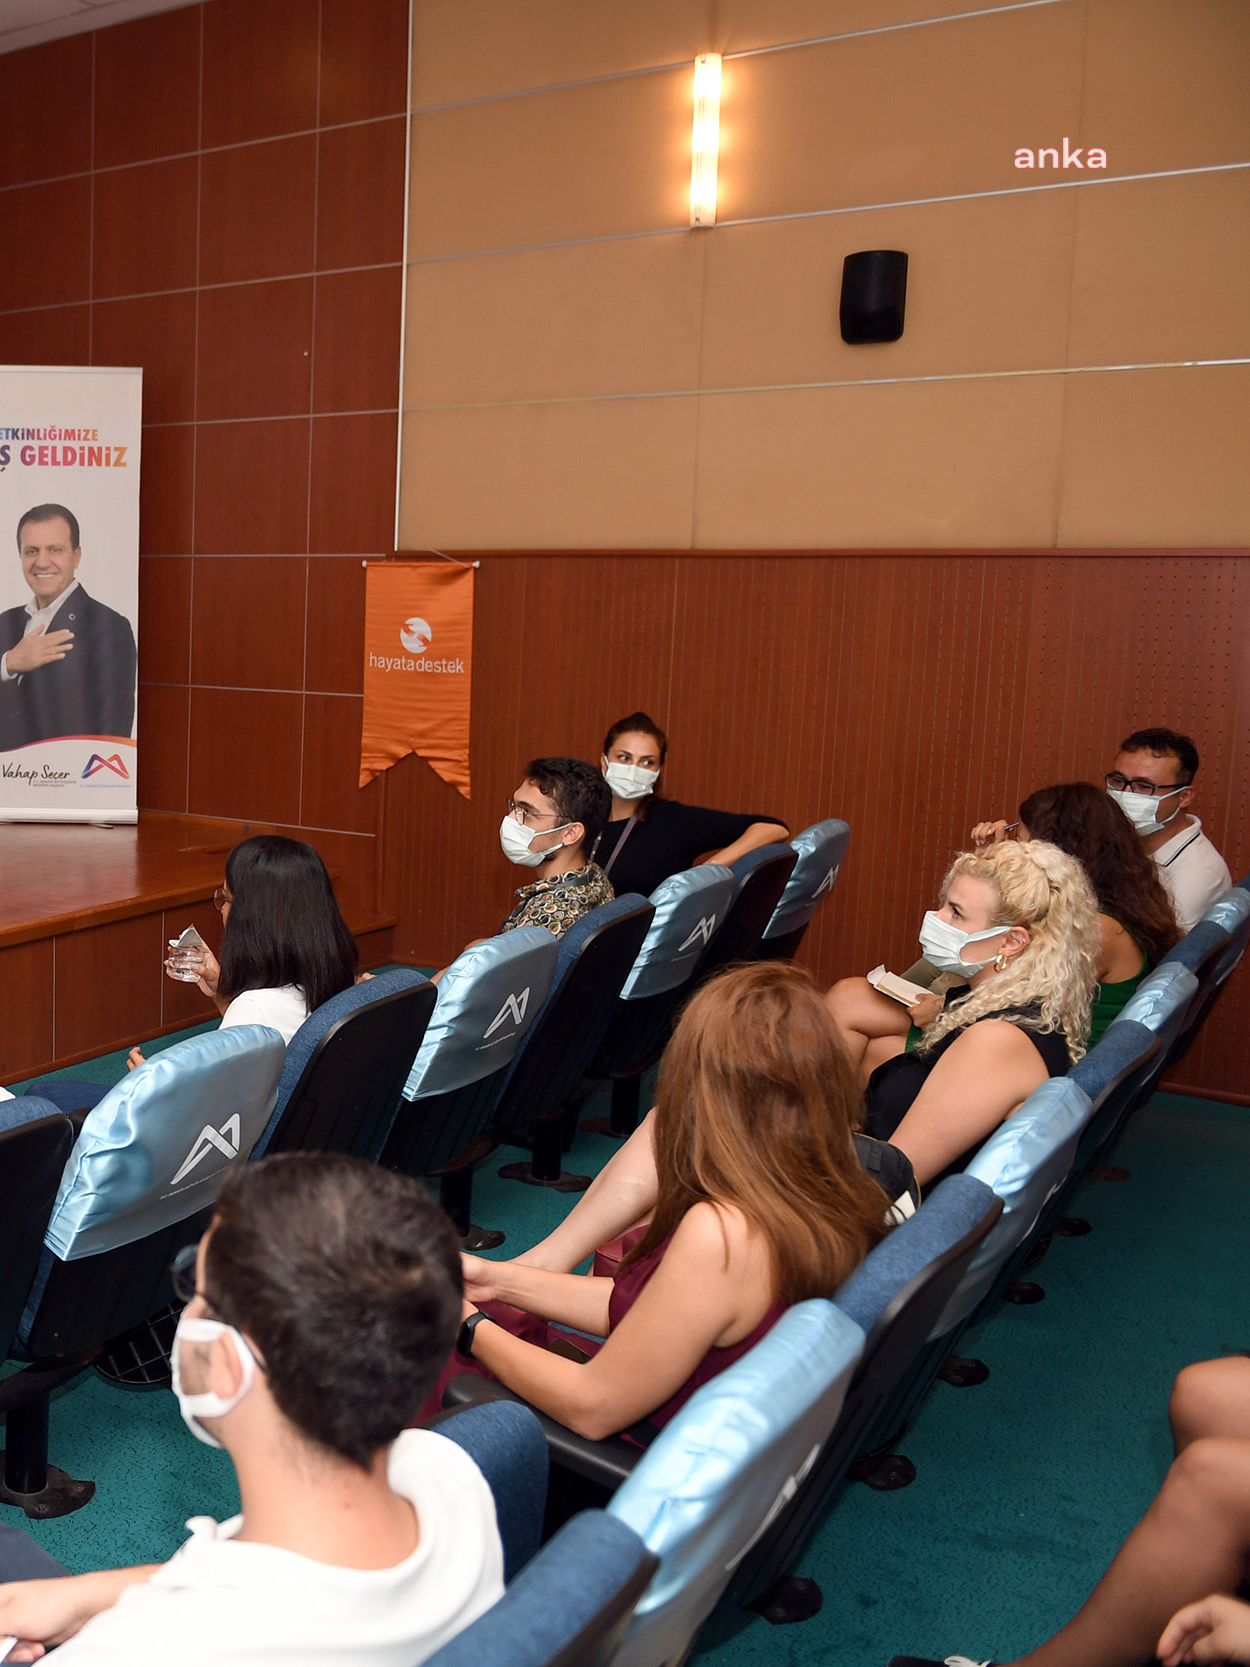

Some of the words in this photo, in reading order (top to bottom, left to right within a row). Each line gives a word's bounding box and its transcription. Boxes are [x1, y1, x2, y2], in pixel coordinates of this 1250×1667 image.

[20, 445, 128, 468] GELDİNİZ
[369, 651, 465, 674] hayatadestek
[2, 762, 39, 786] Vahap
